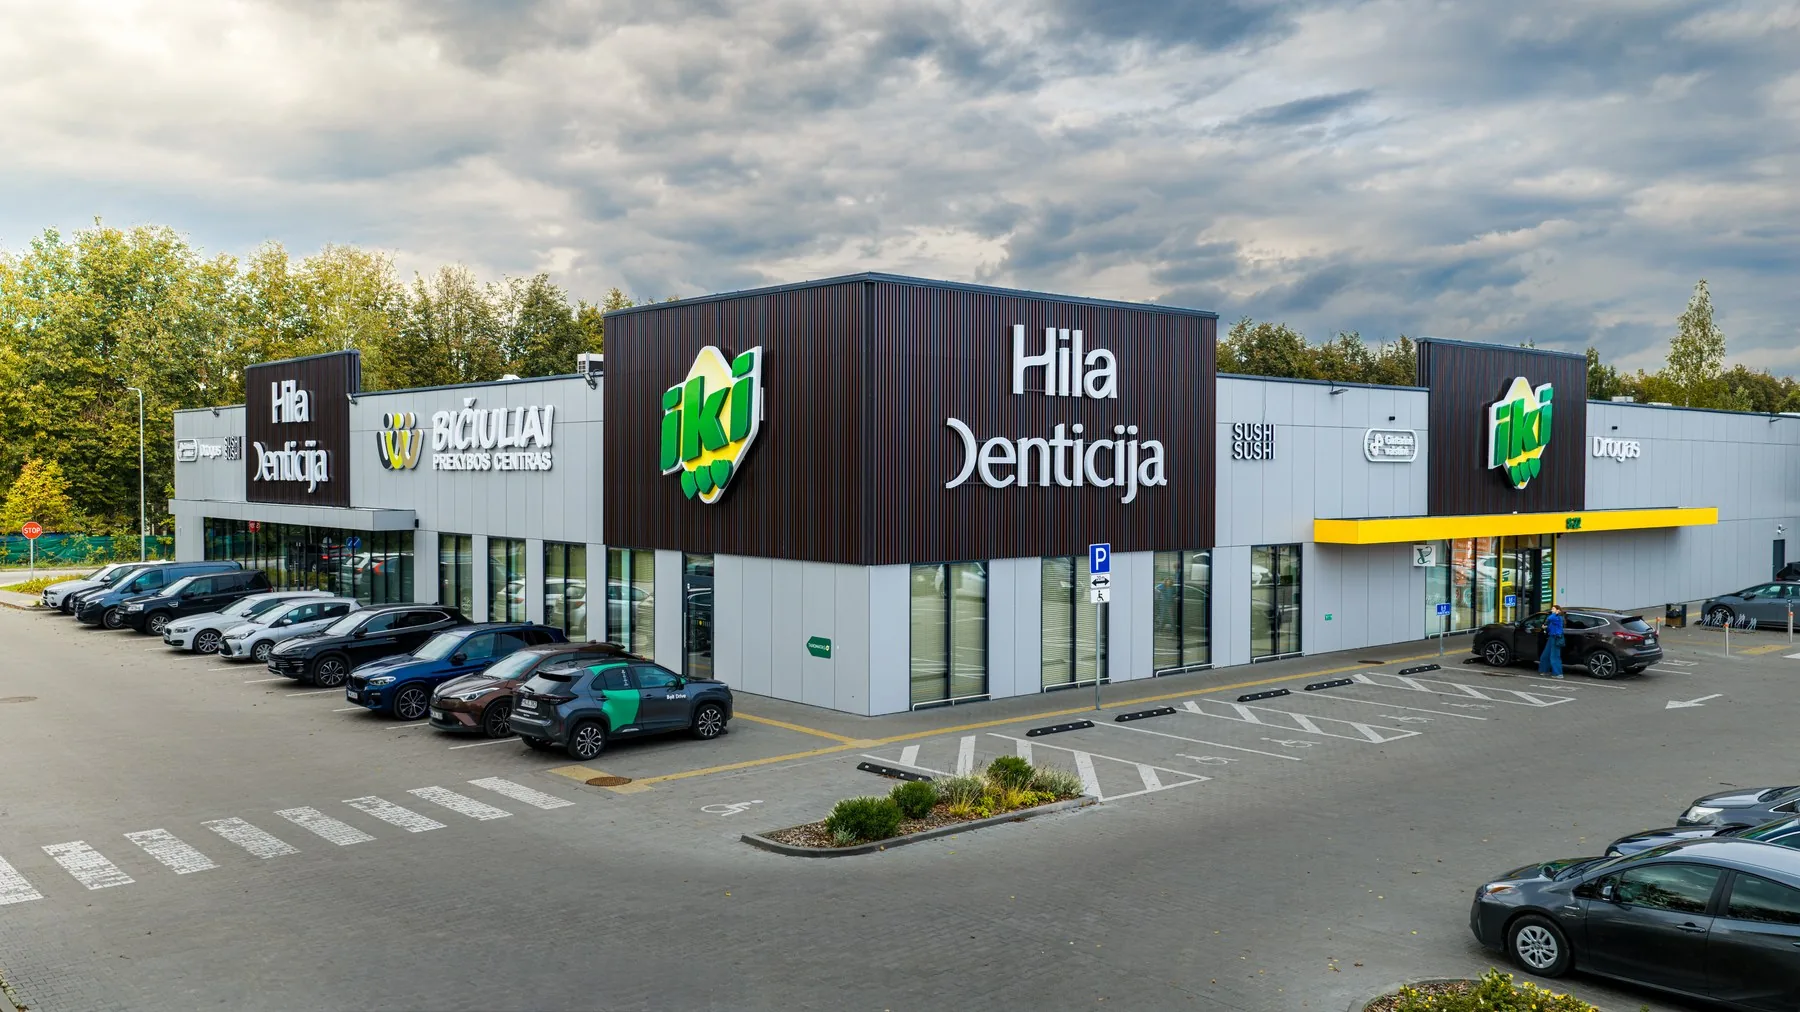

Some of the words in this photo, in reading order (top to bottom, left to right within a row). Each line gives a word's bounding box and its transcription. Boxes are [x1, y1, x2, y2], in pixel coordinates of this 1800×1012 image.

[1012, 324, 1118, 400] Hila
[271, 379, 310, 424] Hila
[432, 397, 555, 451] BIČIULIAI
[660, 351, 755, 472] iki
[1232, 422, 1276, 441] SUSHI
[1232, 441, 1276, 460] SUSHI
[1493, 386, 1554, 467] iki
[1592, 436, 1641, 462] Drogas
[253, 440, 329, 494] Denticija
[432, 453, 492, 471] PREKYBOS
[493, 452, 553, 471] CENTRAS
[945, 417, 1168, 504] Denticija
[1095, 547, 1107, 571] P
